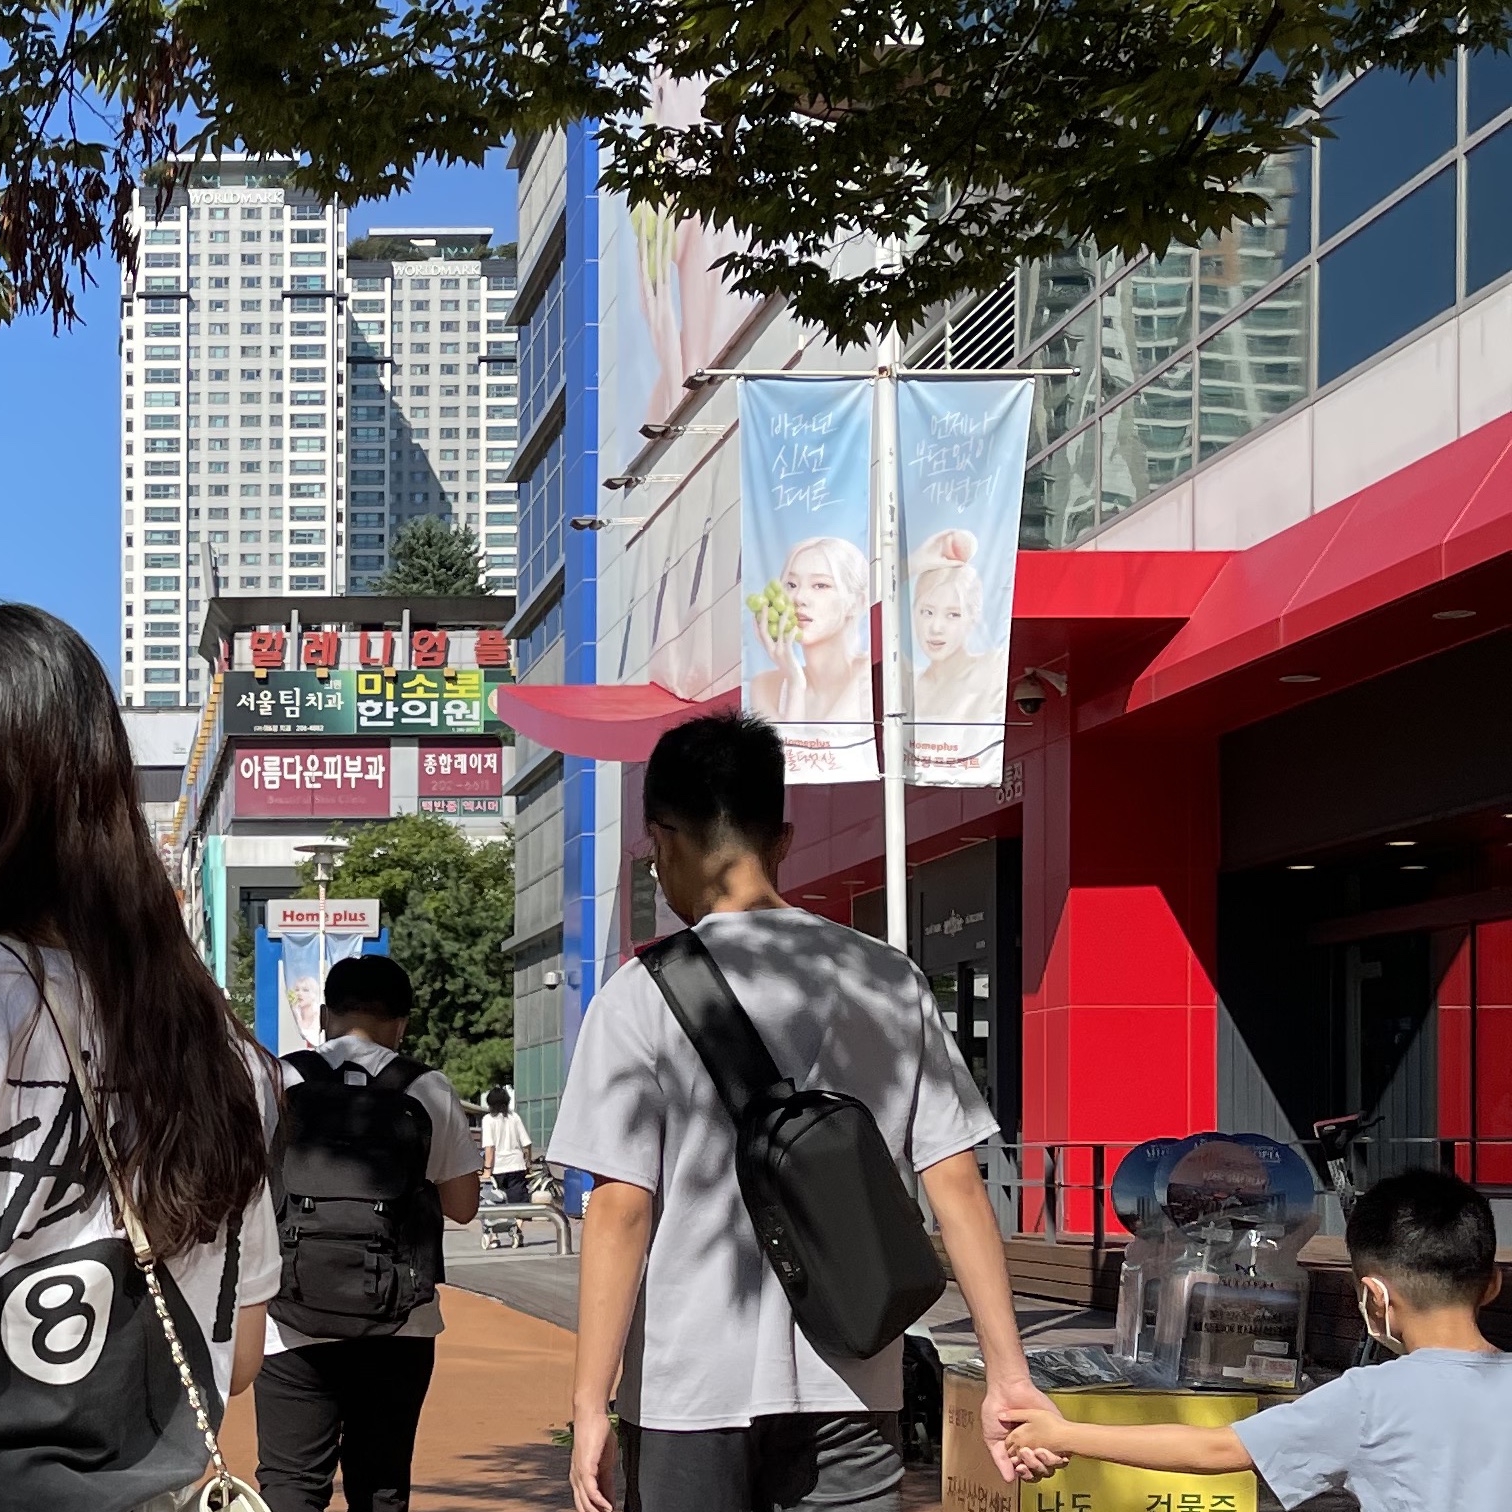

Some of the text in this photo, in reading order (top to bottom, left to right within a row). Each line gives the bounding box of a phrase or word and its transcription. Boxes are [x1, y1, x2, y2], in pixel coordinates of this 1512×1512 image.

[190, 191, 284, 205] WORLDMARK
[393, 262, 480, 277] WORLDMARK
[772, 443, 831, 479] 신선
[356, 699, 481, 728] 한의원
[240, 754, 386, 790] 아름다운피부과
[332, 910, 366, 925] plus
[25, 1274, 95, 1365] 8
